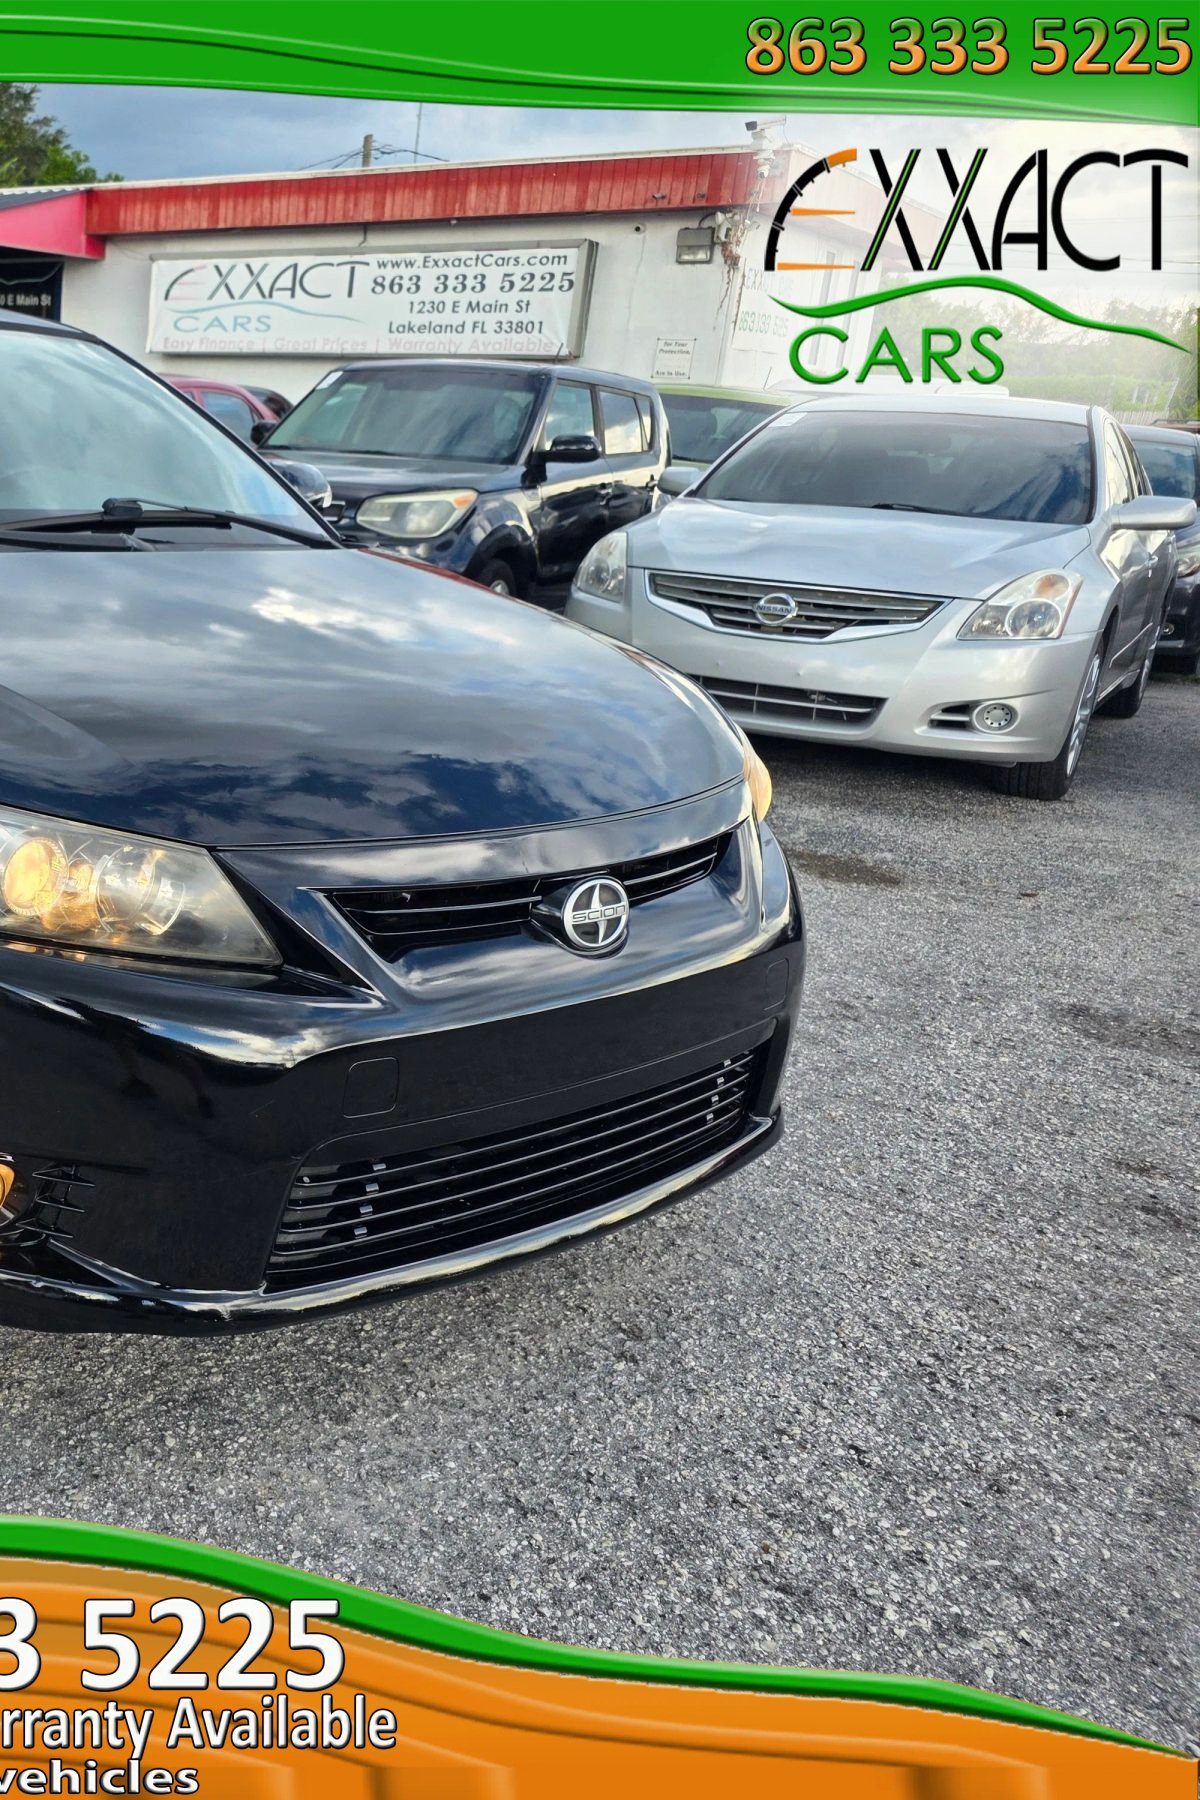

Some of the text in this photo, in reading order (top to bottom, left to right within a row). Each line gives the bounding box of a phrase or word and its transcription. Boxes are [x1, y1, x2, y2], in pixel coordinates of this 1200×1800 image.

[377, 253, 568, 270] www.ExxactCars.com
[164, 260, 370, 300] EXXACT
[371, 271, 575, 295] 863 333 5225
[7, 294, 14, 306] E
[15, 294, 39, 306] Main
[40, 294, 51, 306] St
[408, 299, 530, 314] 1230 E Main St
[173, 315, 272, 333] CARS
[388, 320, 544, 334] Lakeland FL 33801
[163, 337, 555, 354] Easy Finance Great Prices Warranty Available
[756, 605, 792, 614] NISSAN
[572, 905, 626, 923] SCION
